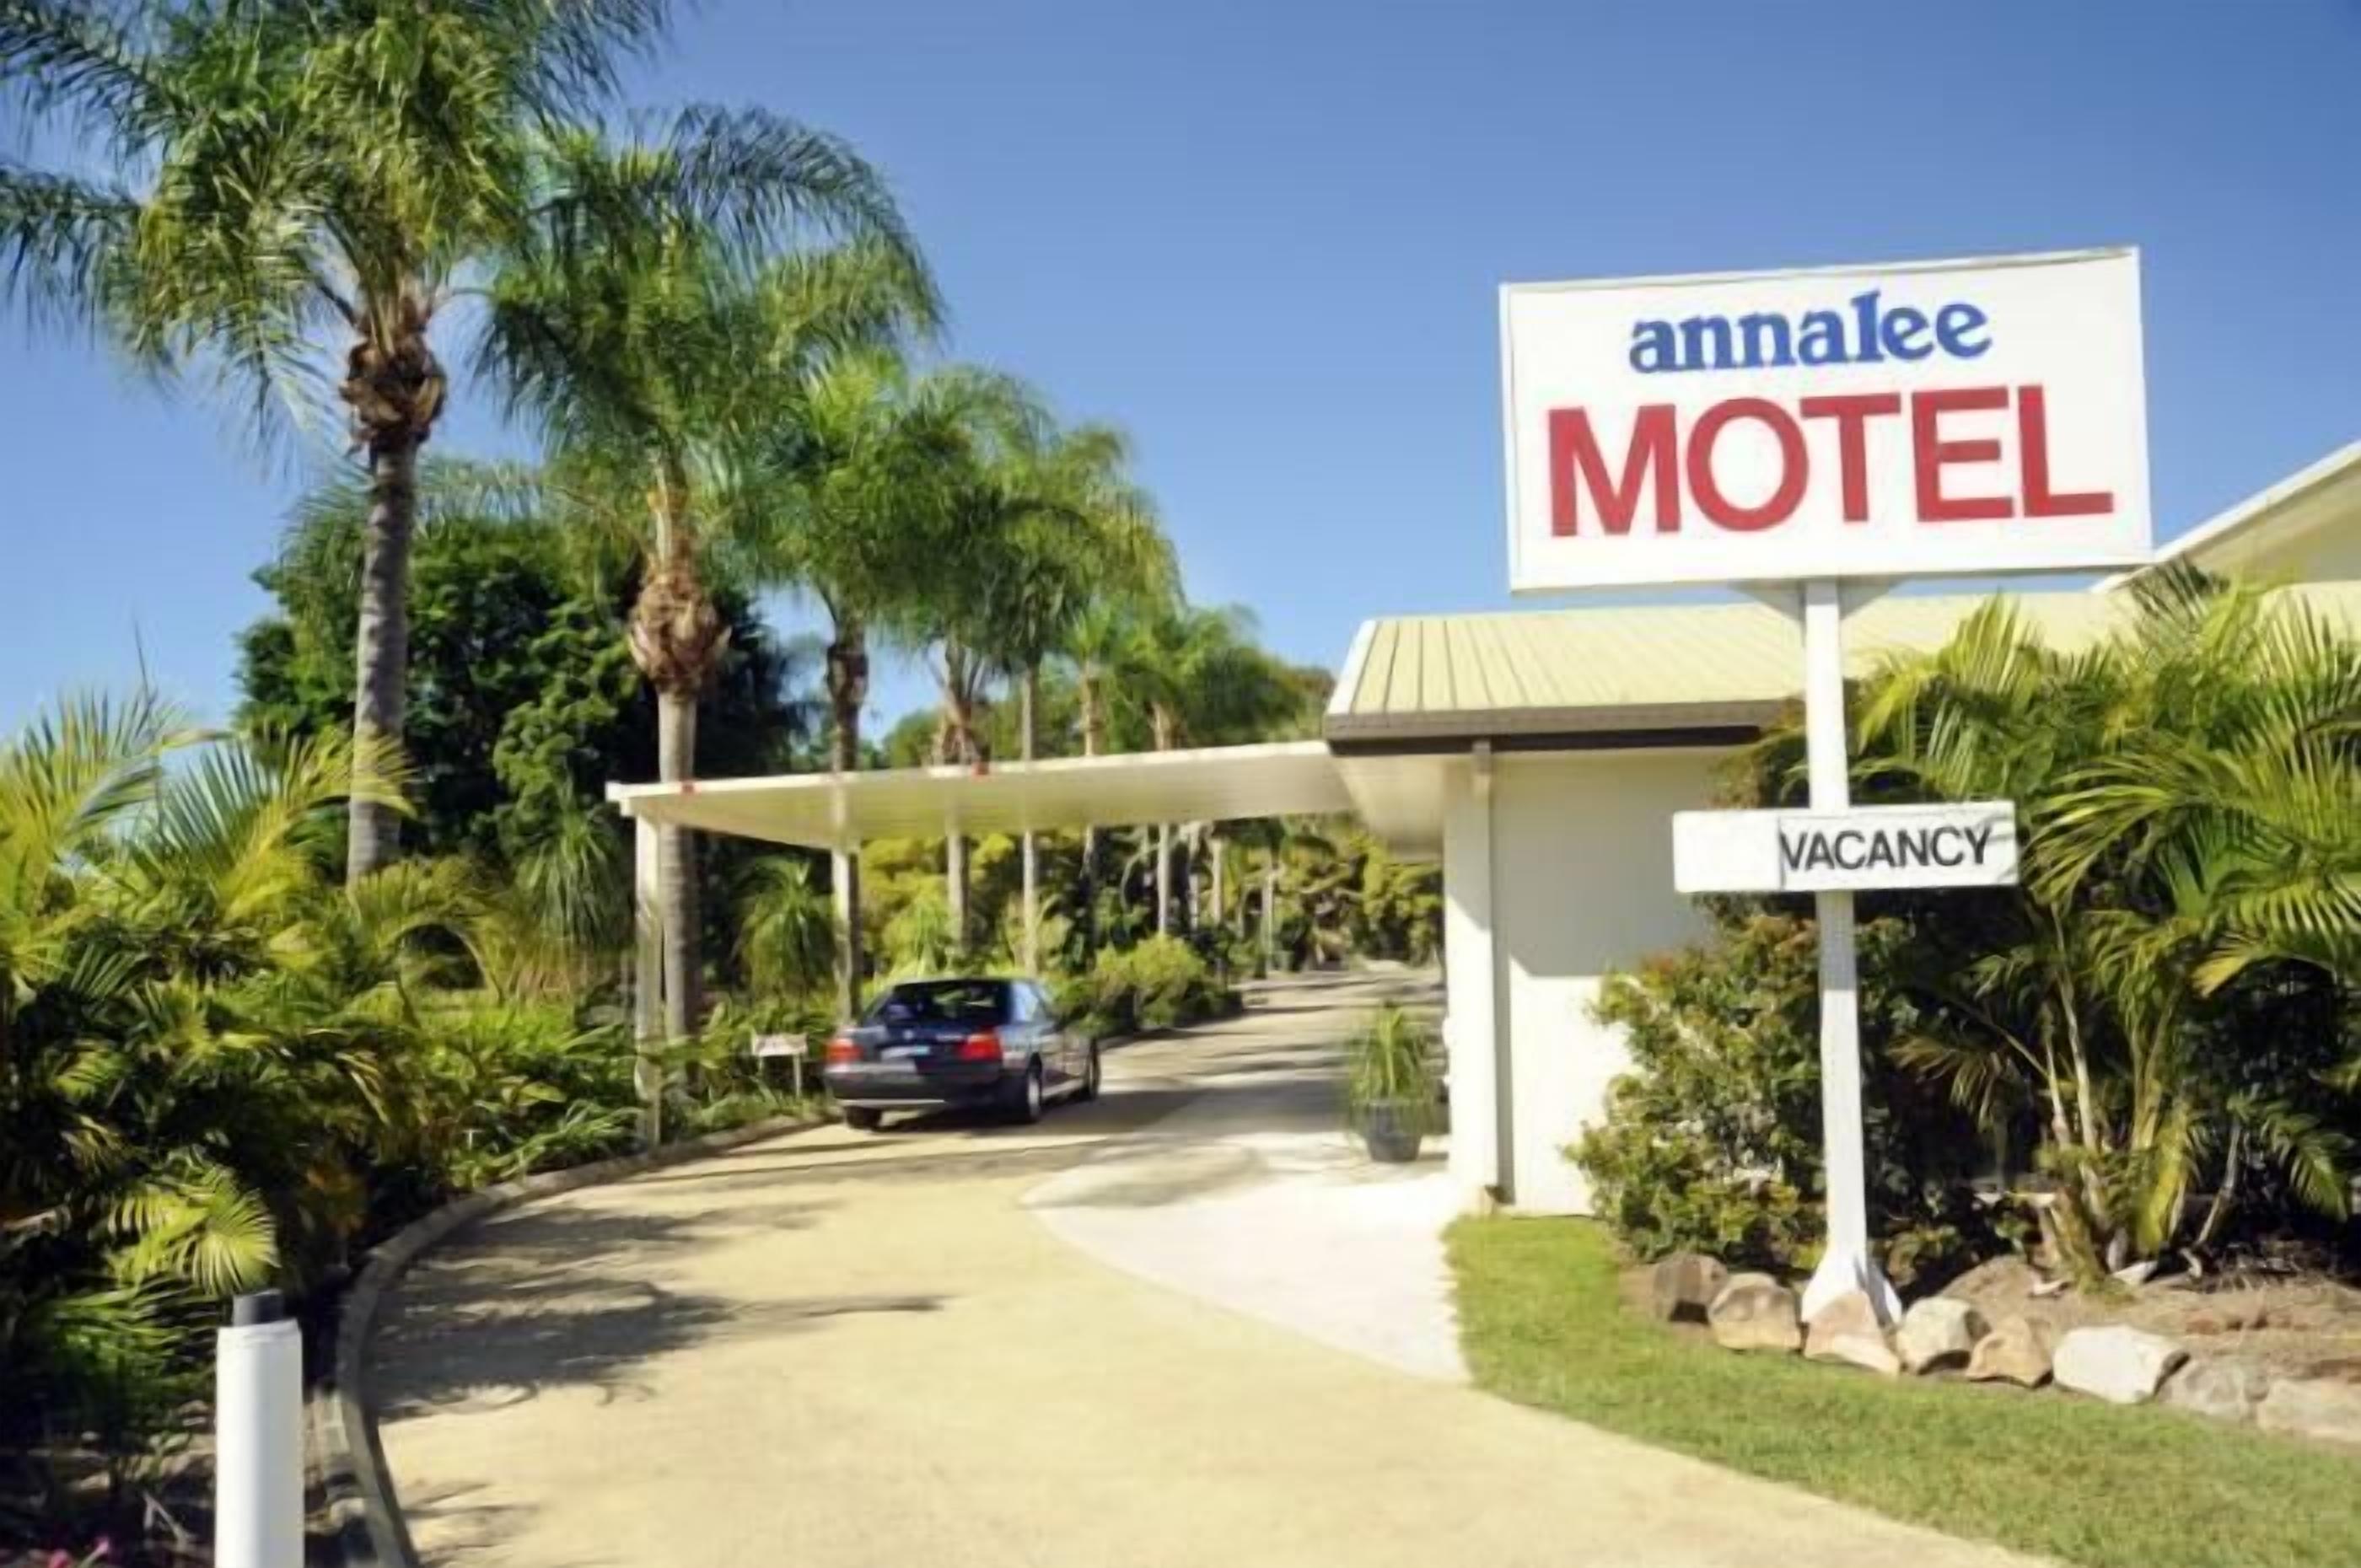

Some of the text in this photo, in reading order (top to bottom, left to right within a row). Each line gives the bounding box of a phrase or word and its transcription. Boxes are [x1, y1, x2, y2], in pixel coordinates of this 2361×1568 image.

[1628, 289, 1993, 373] annalee
[1547, 384, 2114, 537] MOTEL
[1780, 826, 1992, 870] VACANCY
